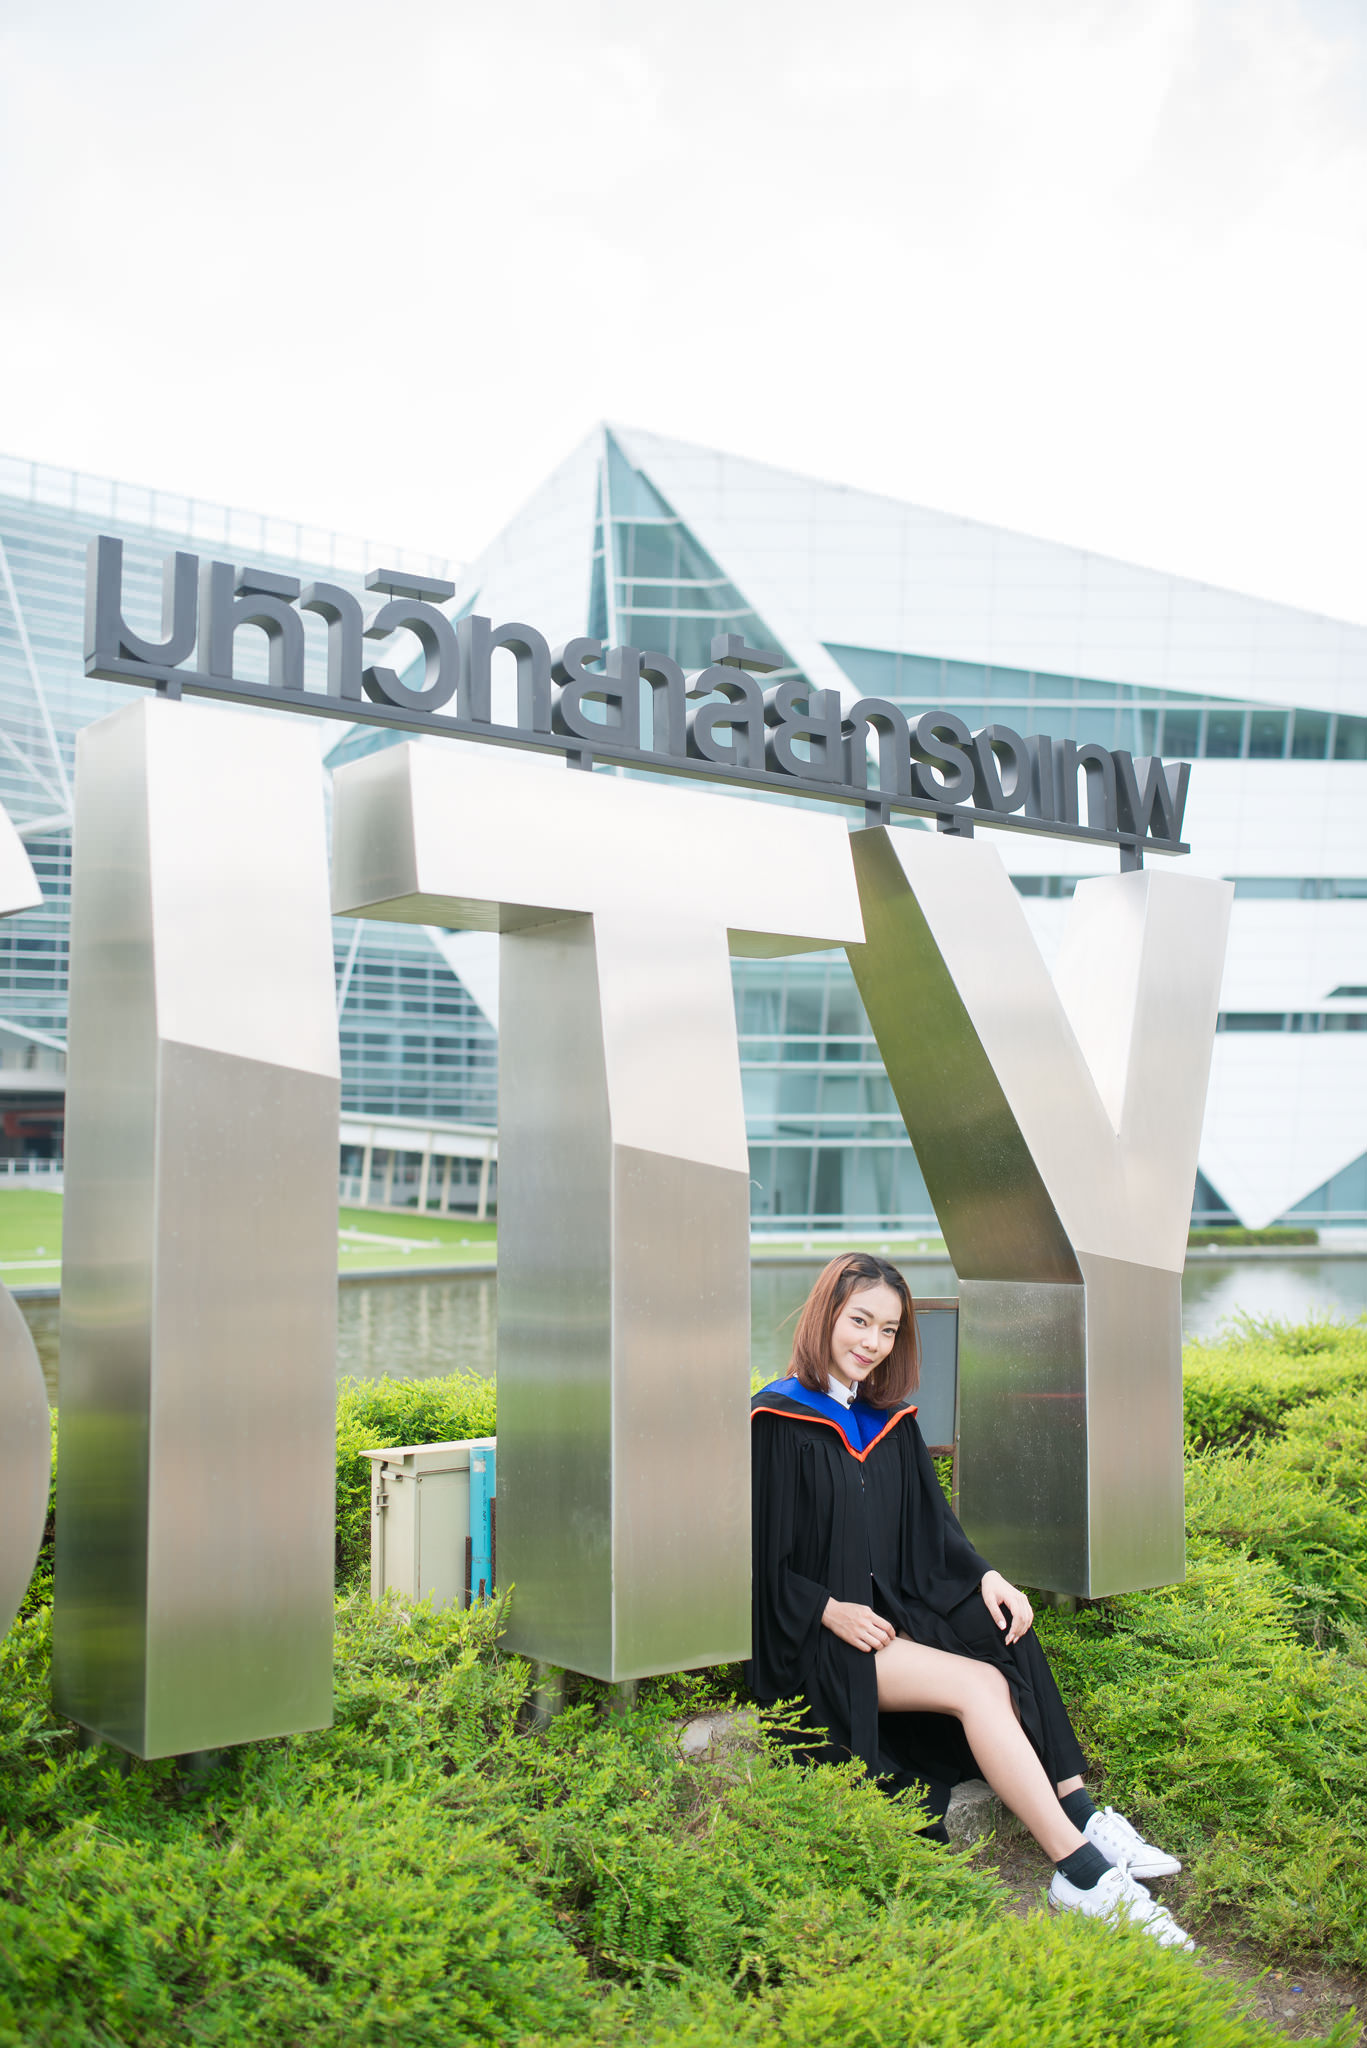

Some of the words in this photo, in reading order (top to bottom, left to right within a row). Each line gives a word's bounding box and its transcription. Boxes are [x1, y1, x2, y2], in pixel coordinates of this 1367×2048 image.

[85, 535, 1191, 838] มหาวิทยาลัยกรุงเทพ
[0, 693, 1235, 1760] ITY
